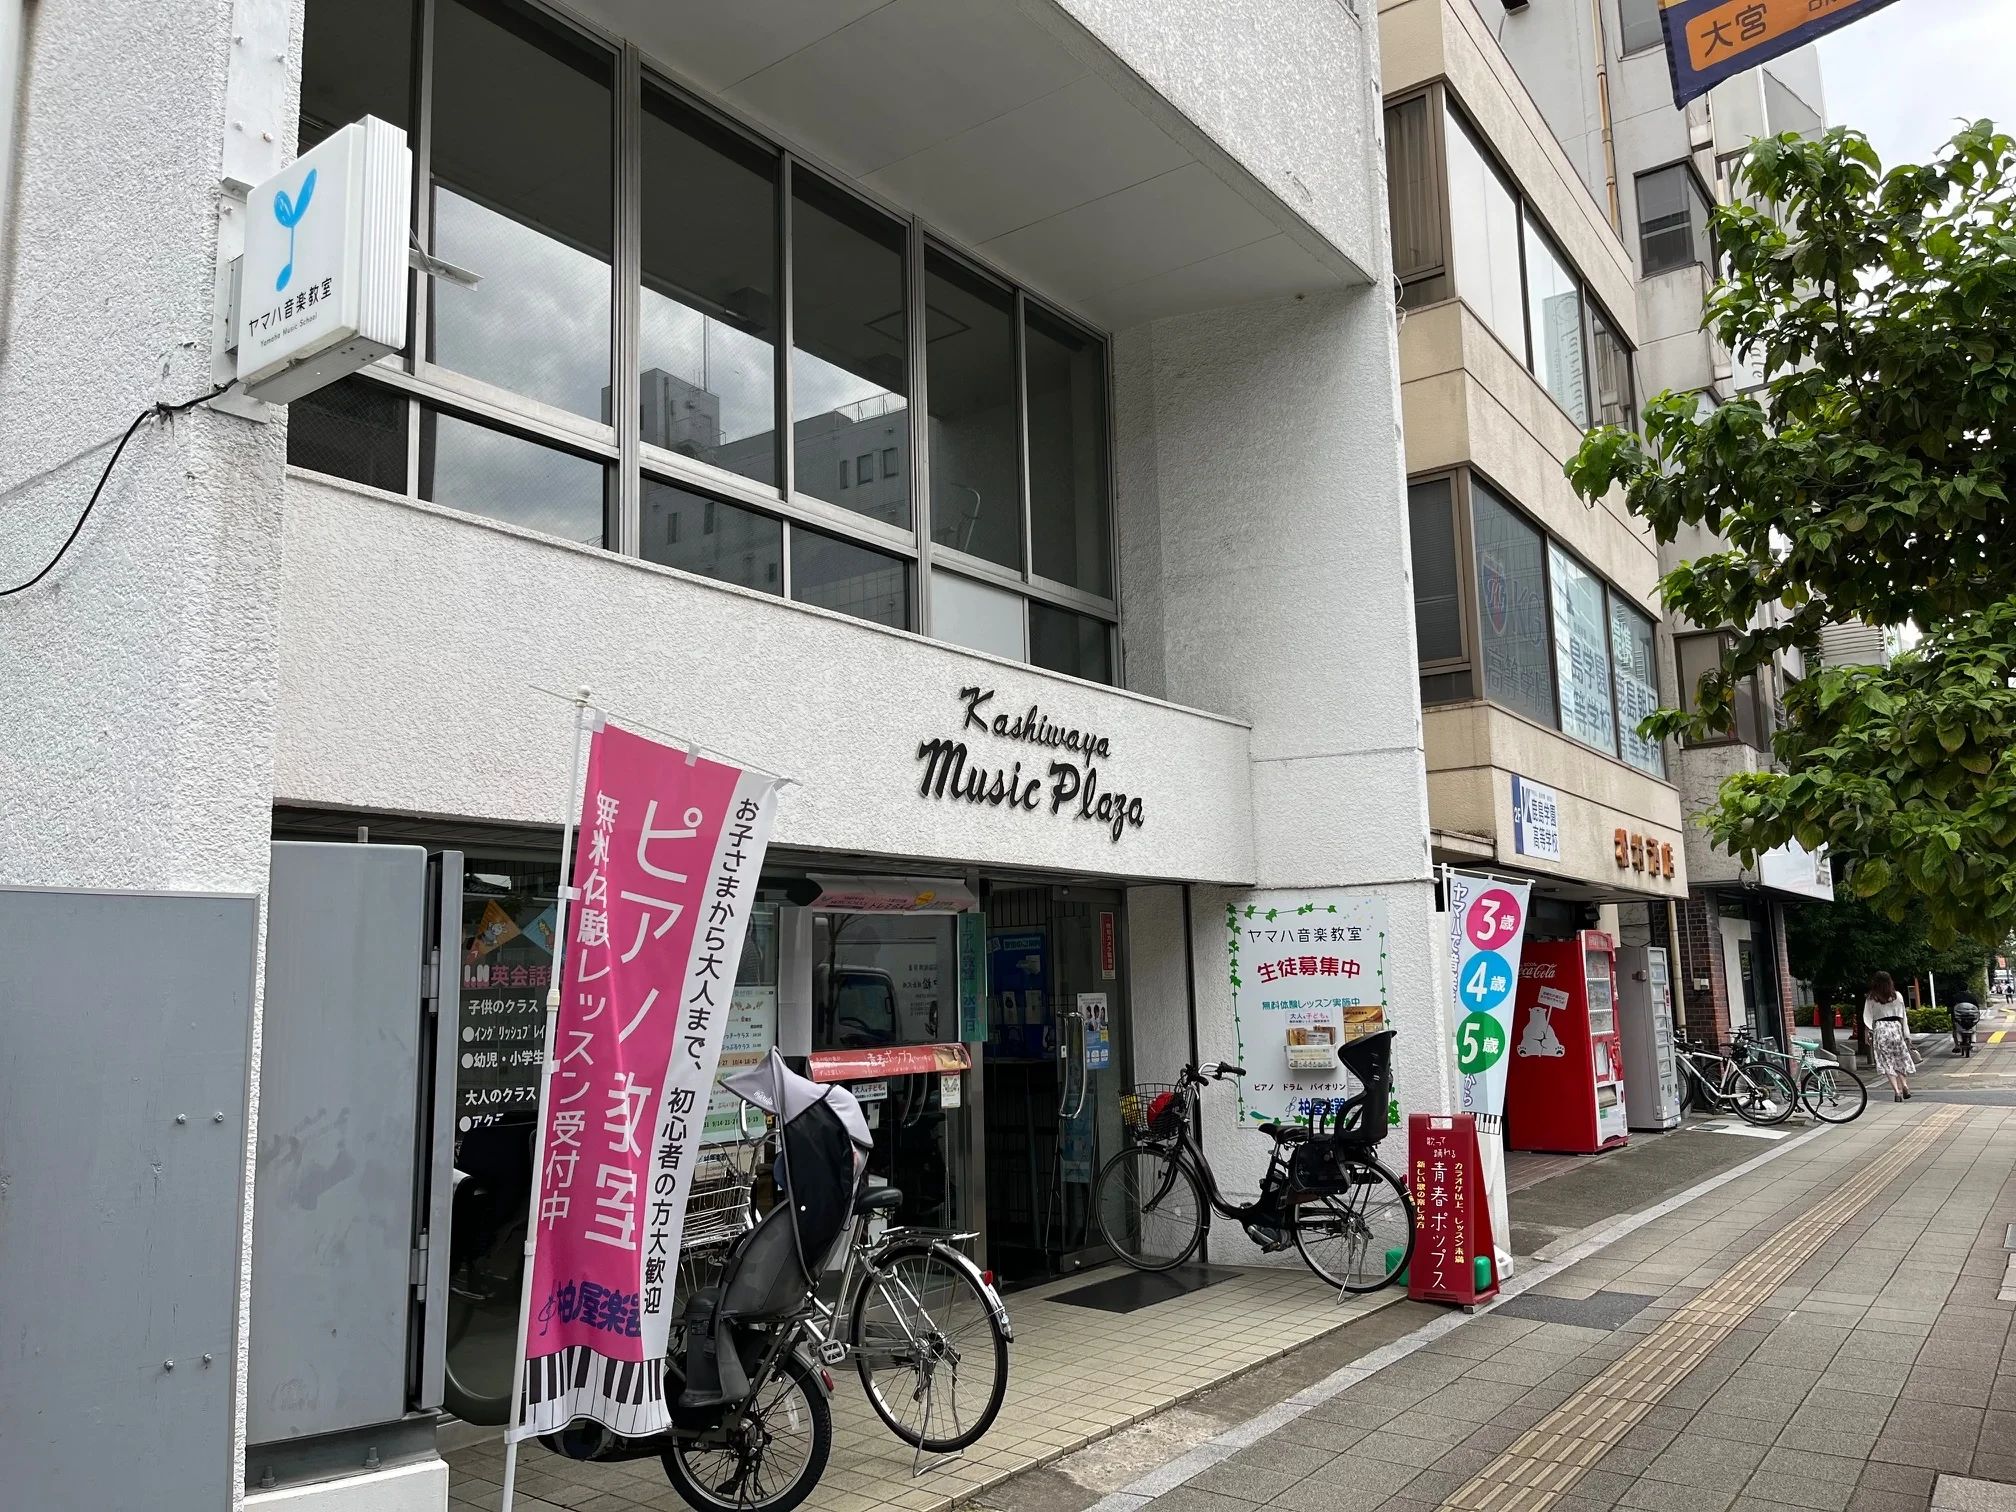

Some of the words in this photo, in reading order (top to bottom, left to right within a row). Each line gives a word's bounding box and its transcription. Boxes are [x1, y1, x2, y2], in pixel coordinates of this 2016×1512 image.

[1700, 1, 1768, 58] 大宮
[248, 276, 332, 337] ヤマハ音楽教室
[260, 332, 281, 348] Yamaha
[282, 322, 298, 337] Music
[299, 311, 318, 329] School
[959, 686, 1111, 768] Kashiwaya
[917, 738, 1041, 810] Music
[1048, 760, 1144, 843] Plaza
[1247, 926, 1363, 944] ヤマハ音楽教室
[1476, 898, 1515, 941] 3歳
[1257, 956, 1361, 984] 生徒募集中
[1465, 961, 1507, 1003] 4歳
[468, 999, 539, 1016] 子供のクラス
[1262, 997, 1361, 1011] 無料体験レッスン実施中
[473, 1049, 545, 1068] 幼児・小学生
[1461, 1022, 1500, 1064] 5歳
[465, 1086, 537, 1106] 大人のクラス
[1254, 1083, 1275, 1092] ピアノ
[1283, 1083, 1303, 1092] ドラム
[1310, 1082, 1346, 1091] バイオリン
[1416, 1160, 1426, 1229] 新しい歌の楽しみ方
[1430, 1161, 1448, 1290] 青春ポップス
